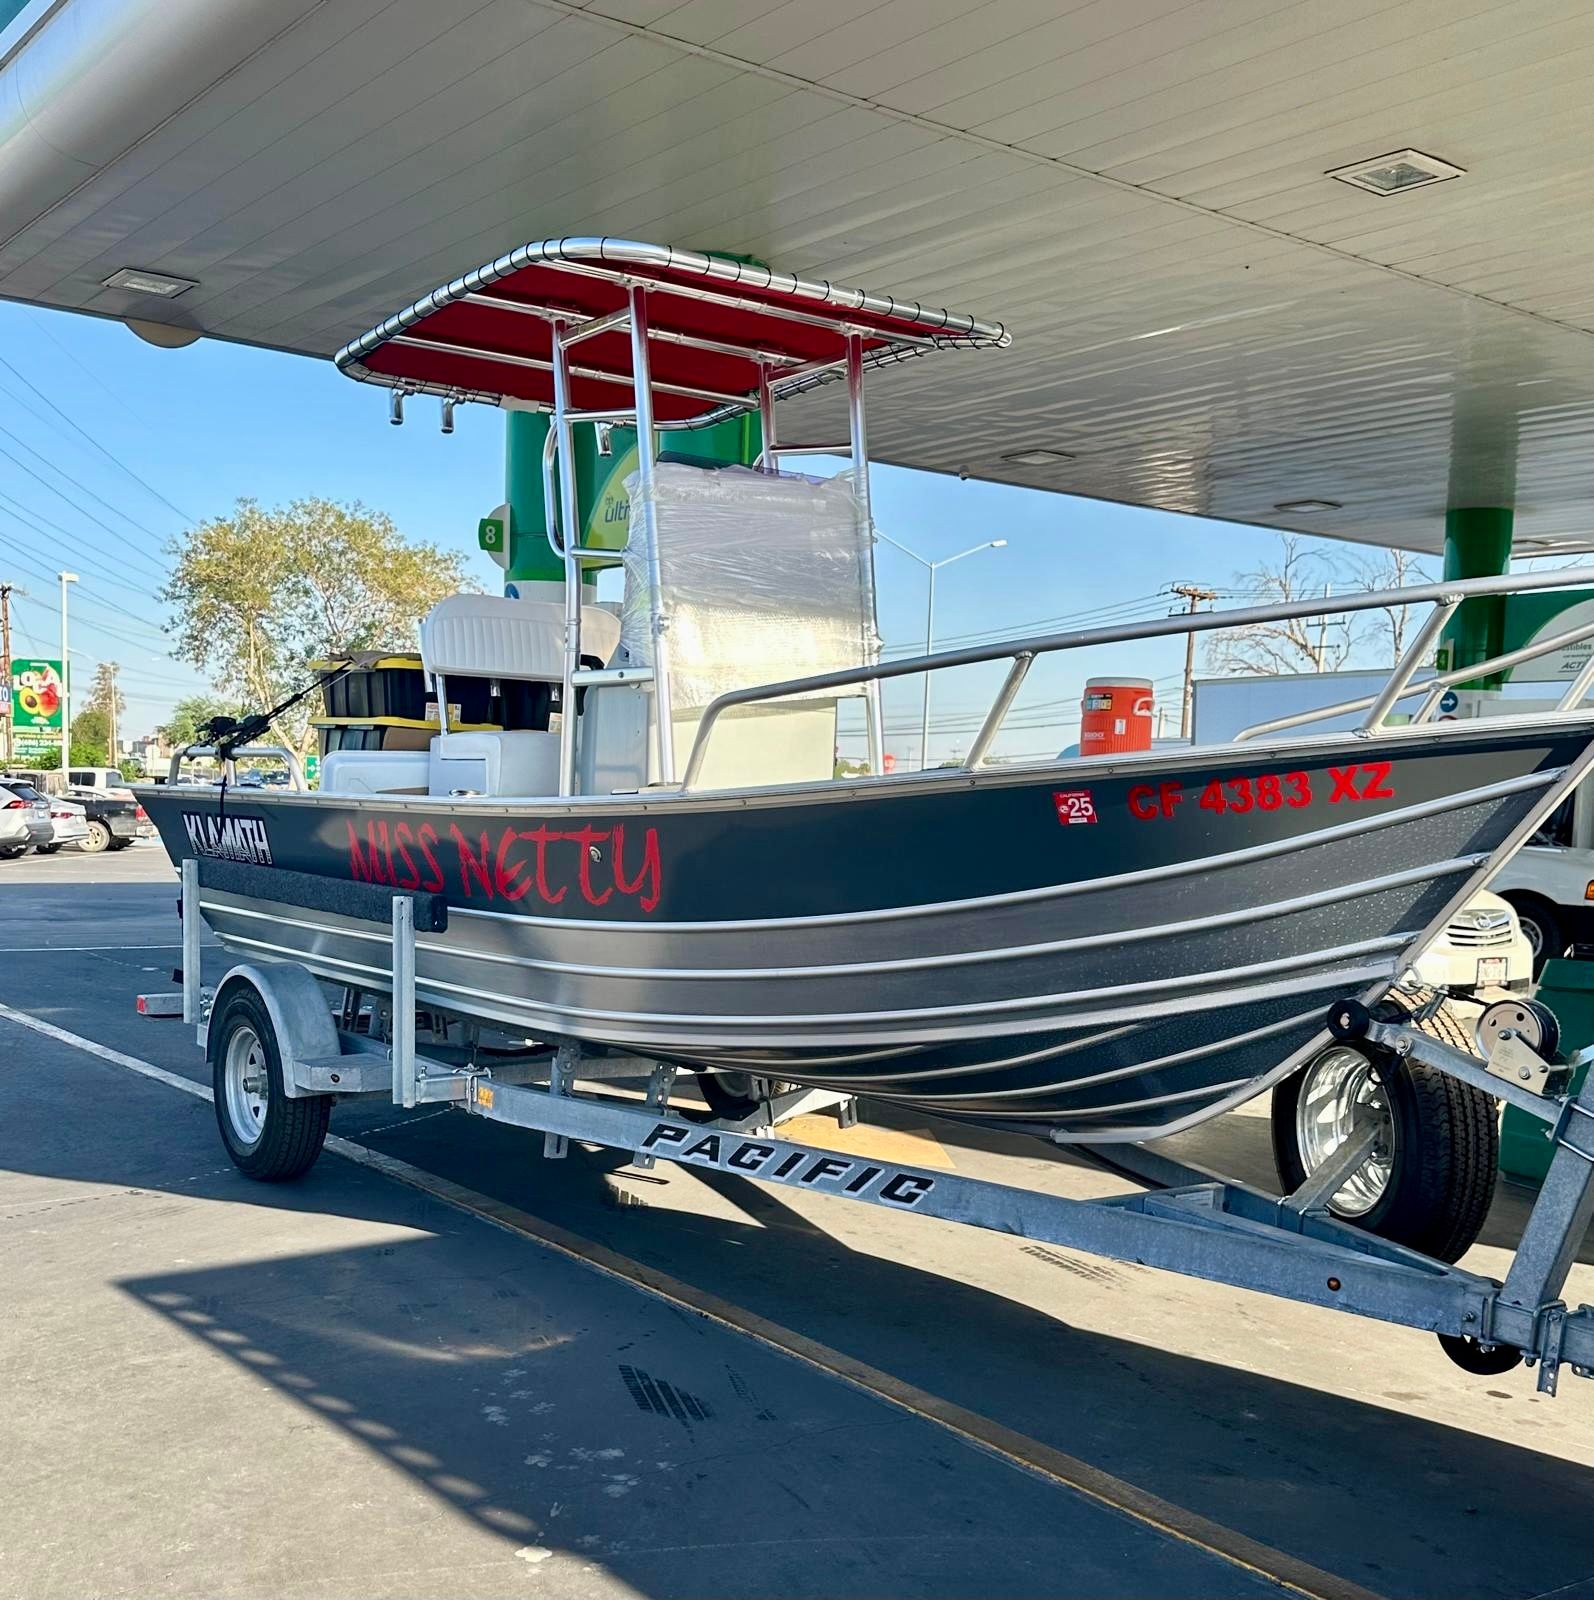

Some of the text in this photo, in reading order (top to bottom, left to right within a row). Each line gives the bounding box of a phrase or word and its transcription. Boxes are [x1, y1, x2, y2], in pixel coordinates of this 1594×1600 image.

[485, 525, 496, 545] 8
[1067, 797, 1094, 817] 25
[1127, 760, 1395, 821] CF 4383 XZ
[182, 813, 273, 865] KLAMATH
[345, 816, 445, 893] MISS
[640, 1122, 935, 1206] PACIFIC
